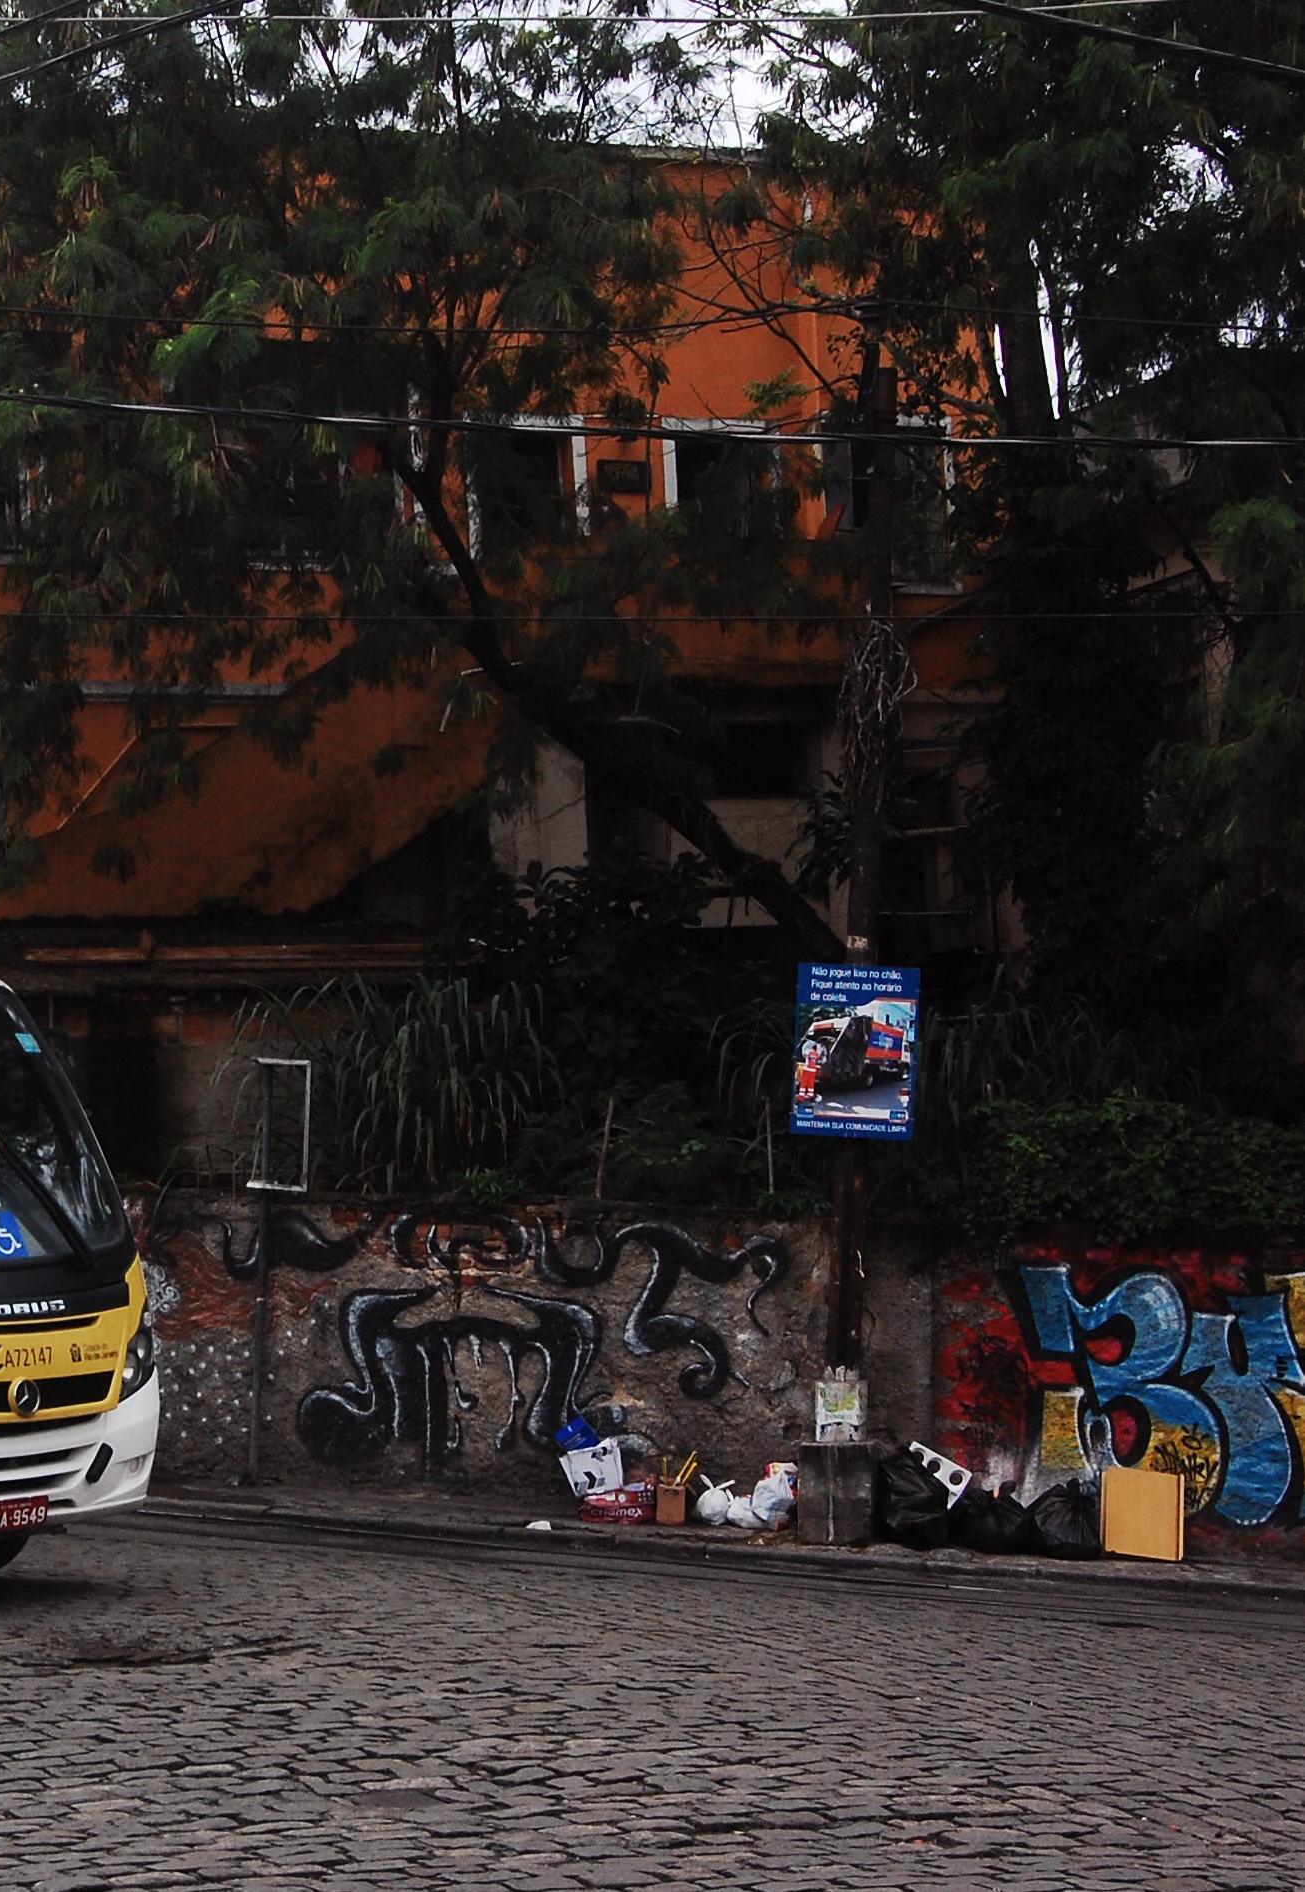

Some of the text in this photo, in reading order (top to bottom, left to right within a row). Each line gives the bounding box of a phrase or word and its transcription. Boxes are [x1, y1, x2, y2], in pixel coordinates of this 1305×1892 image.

[811, 966, 828, 976] Não
[829, 968, 852, 979] jogue
[869, 970, 880, 978] no
[811, 979, 902, 992] Fique atento ao horário
[810, 992, 821, 1001] de
[796, 1119, 831, 1128] MANTENHA
[831, 1122, 845, 1130] SUA
[845, 1123, 886, 1132] COMUNIDADE
[5, 1346, 53, 1368] A72147
